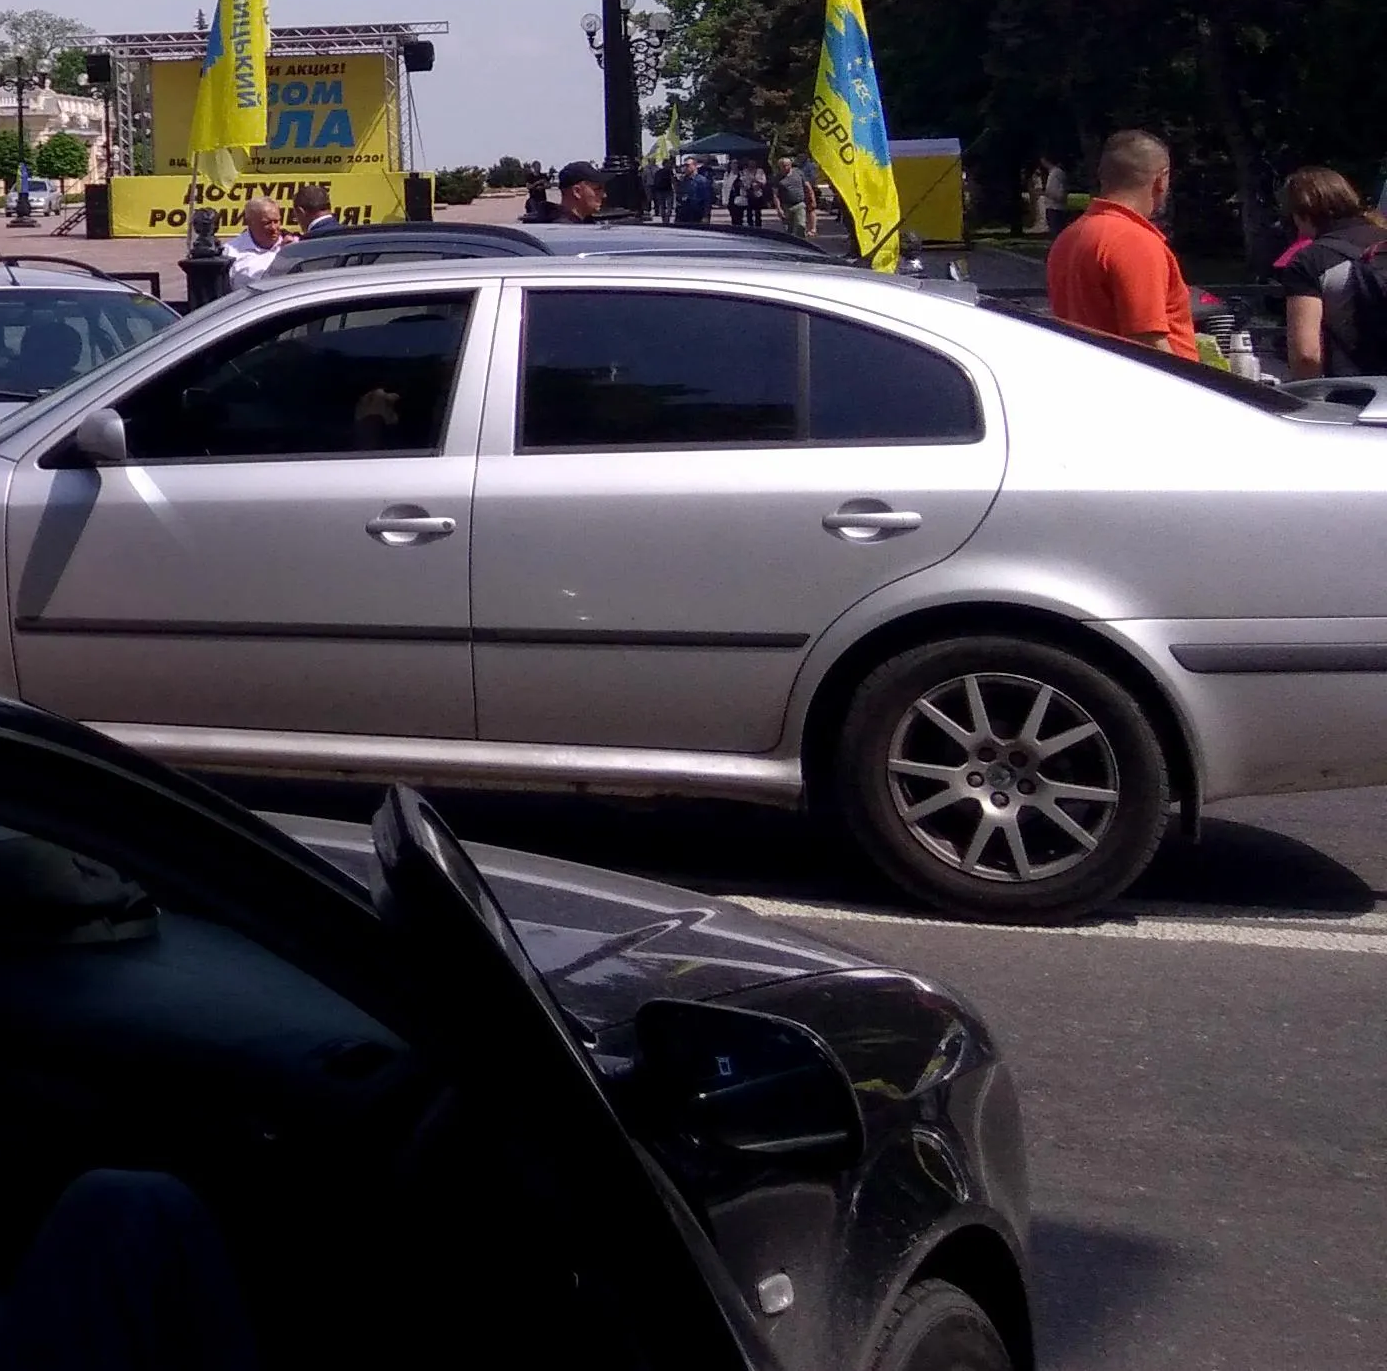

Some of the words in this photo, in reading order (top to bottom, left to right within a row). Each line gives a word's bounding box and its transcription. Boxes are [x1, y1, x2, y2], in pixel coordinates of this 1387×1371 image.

[285, 63, 346, 78] АКЦИЗ!
[269, 156, 321, 167] ШТРАФИ
[324, 154, 343, 166] ДО
[346, 154, 385, 164] 2020!
